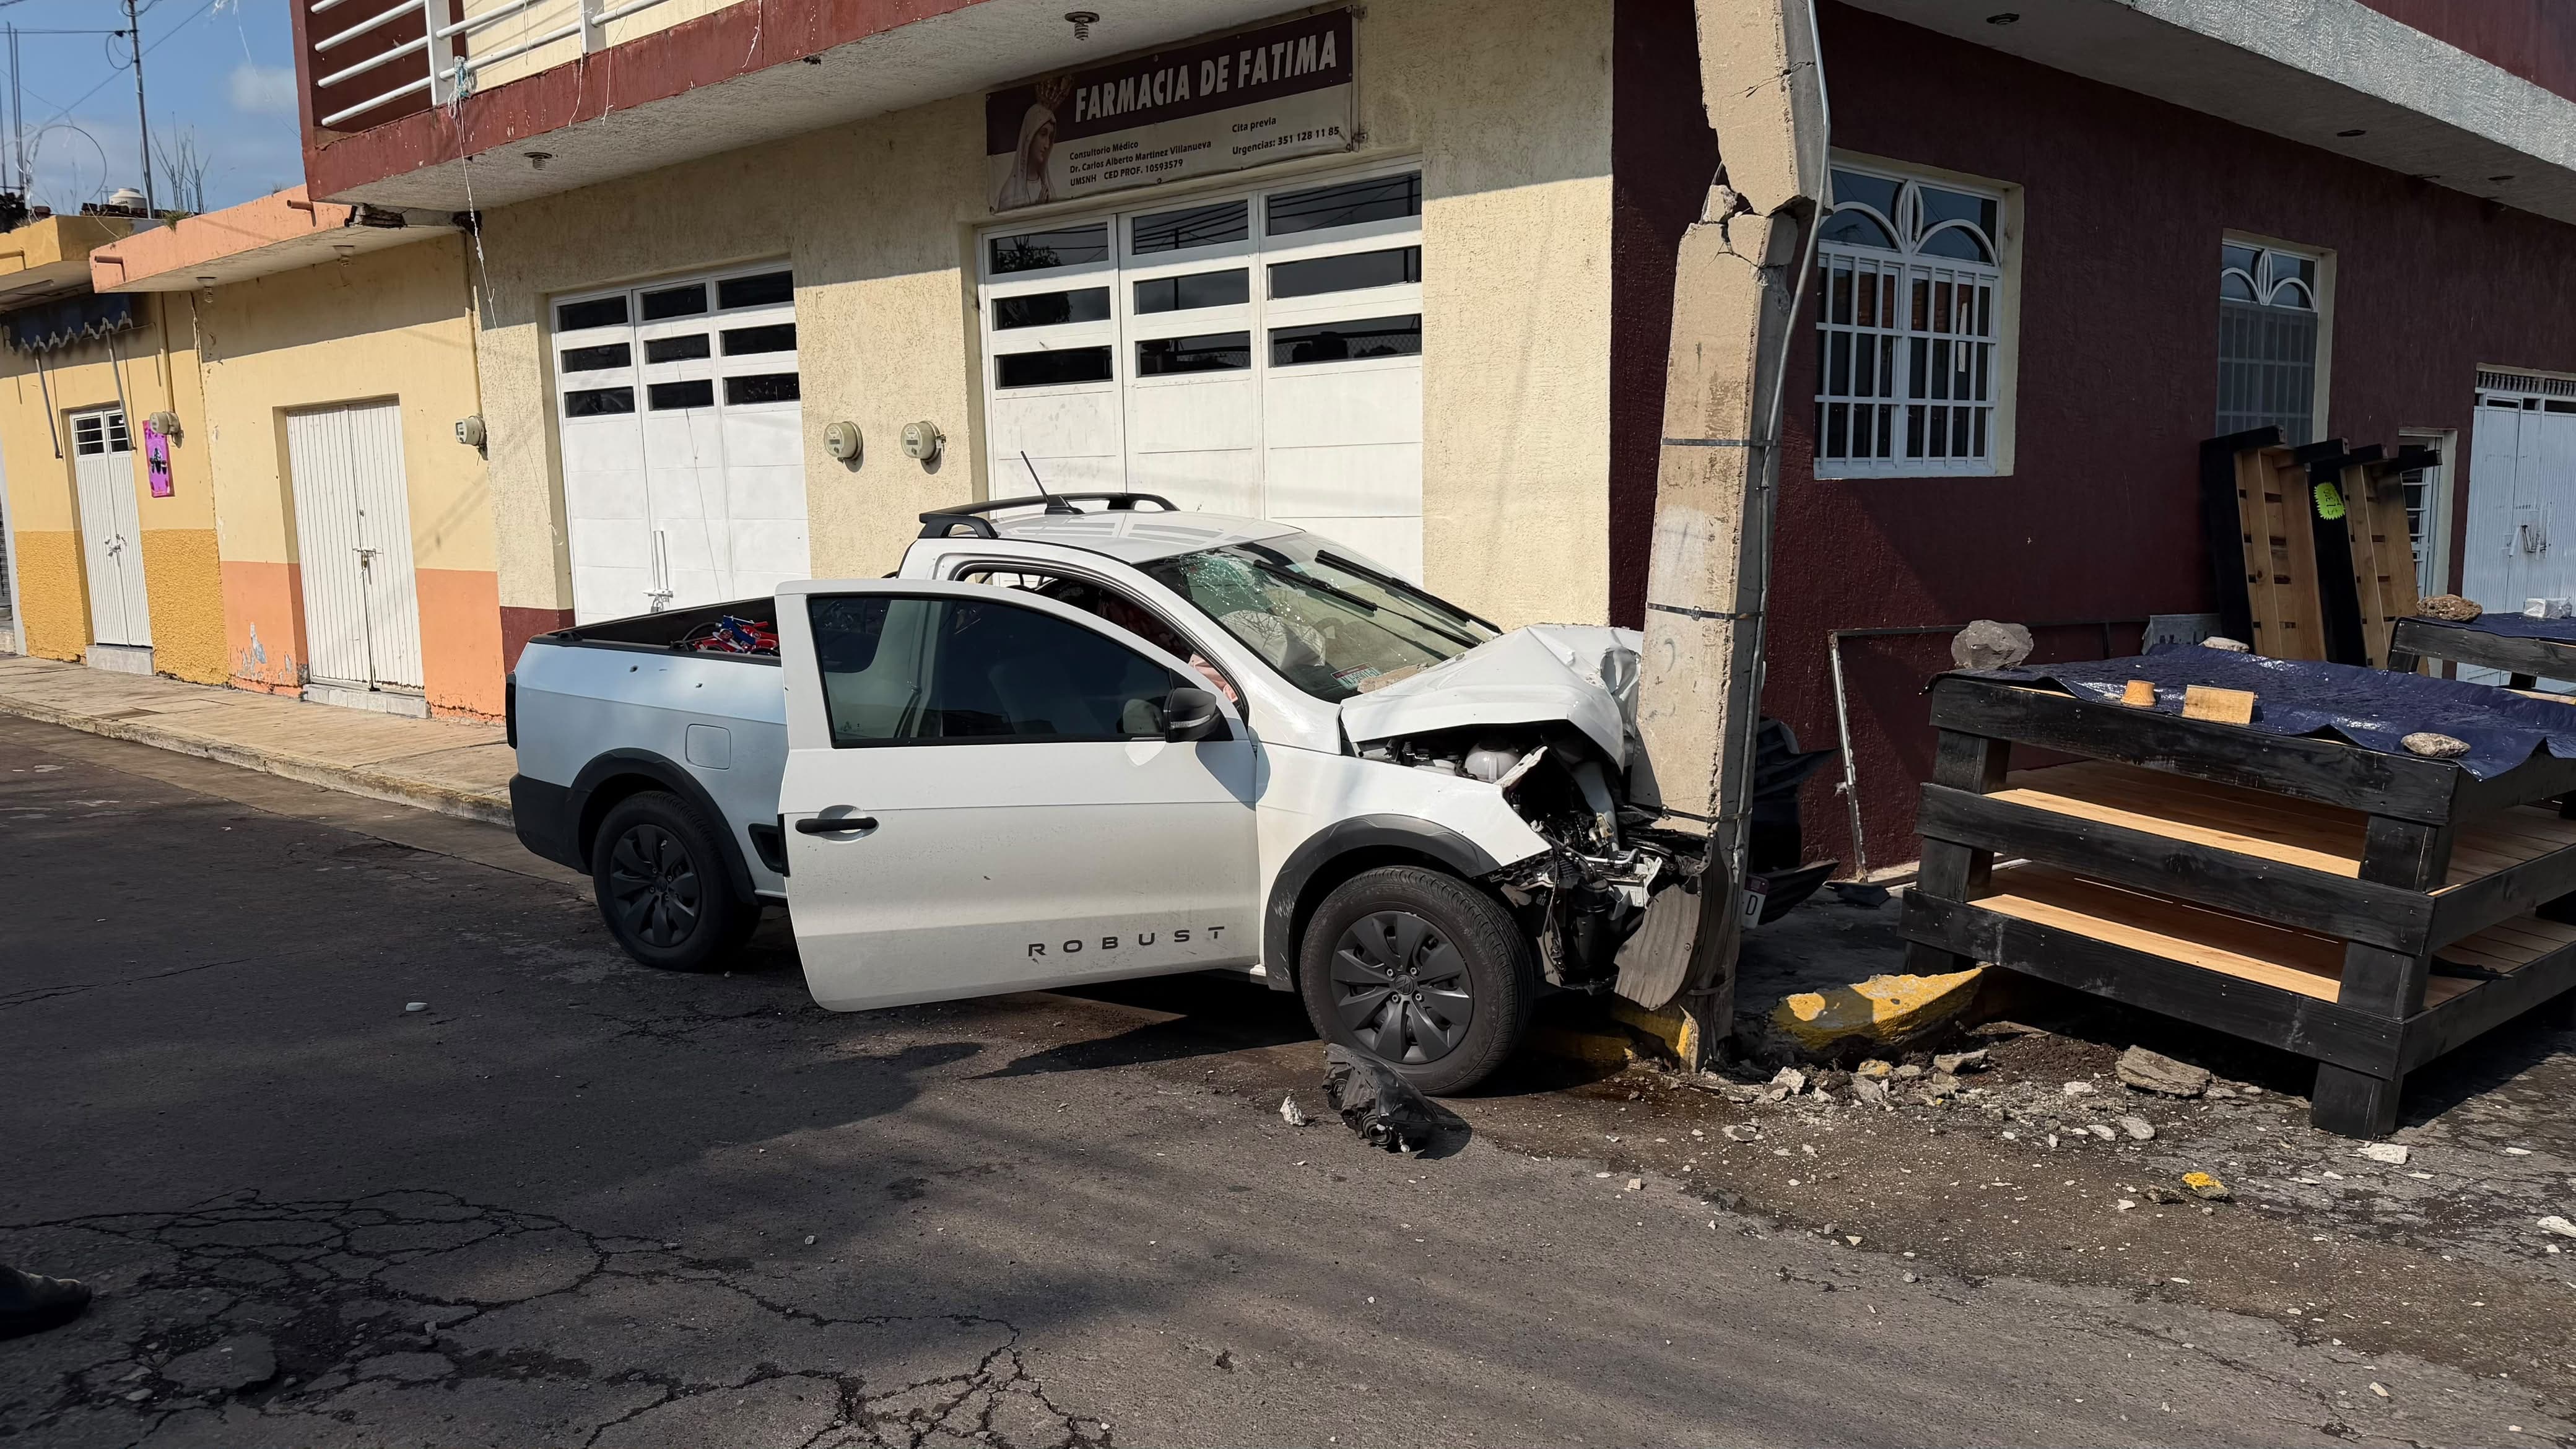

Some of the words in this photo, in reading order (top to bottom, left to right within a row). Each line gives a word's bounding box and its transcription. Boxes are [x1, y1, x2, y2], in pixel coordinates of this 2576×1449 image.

[1075, 64, 1190, 123] FARMACIA
[1199, 54, 1230, 97] DE
[1238, 30, 1337, 89] FATIMA
[1232, 124, 1248, 133] Cita
[1250, 117, 1276, 131] previa
[1070, 146, 1110, 160] Consultorio
[1113, 142, 1139, 152] Médico
[1232, 140, 1276, 155] Urgencias:
[1278, 135, 1293, 146] 351
[1297, 131, 1312, 141] 128
[1316, 129, 1325, 138] 11
[1328, 126, 1339, 136] 85
[1070, 165, 1081, 173] Dr.
[1082, 161, 1104, 171] Carlos
[1105, 156, 1133, 167] Alberto
[1170, 141, 1212, 154] Villanueva
[1070, 174, 1097, 186] UMSNH
[1104, 170, 1119, 180] CED
[1121, 167, 1142, 177] PROF.
[1146, 159, 1183, 173] 10593579
[1028, 926, 1225, 957] ROBUST
